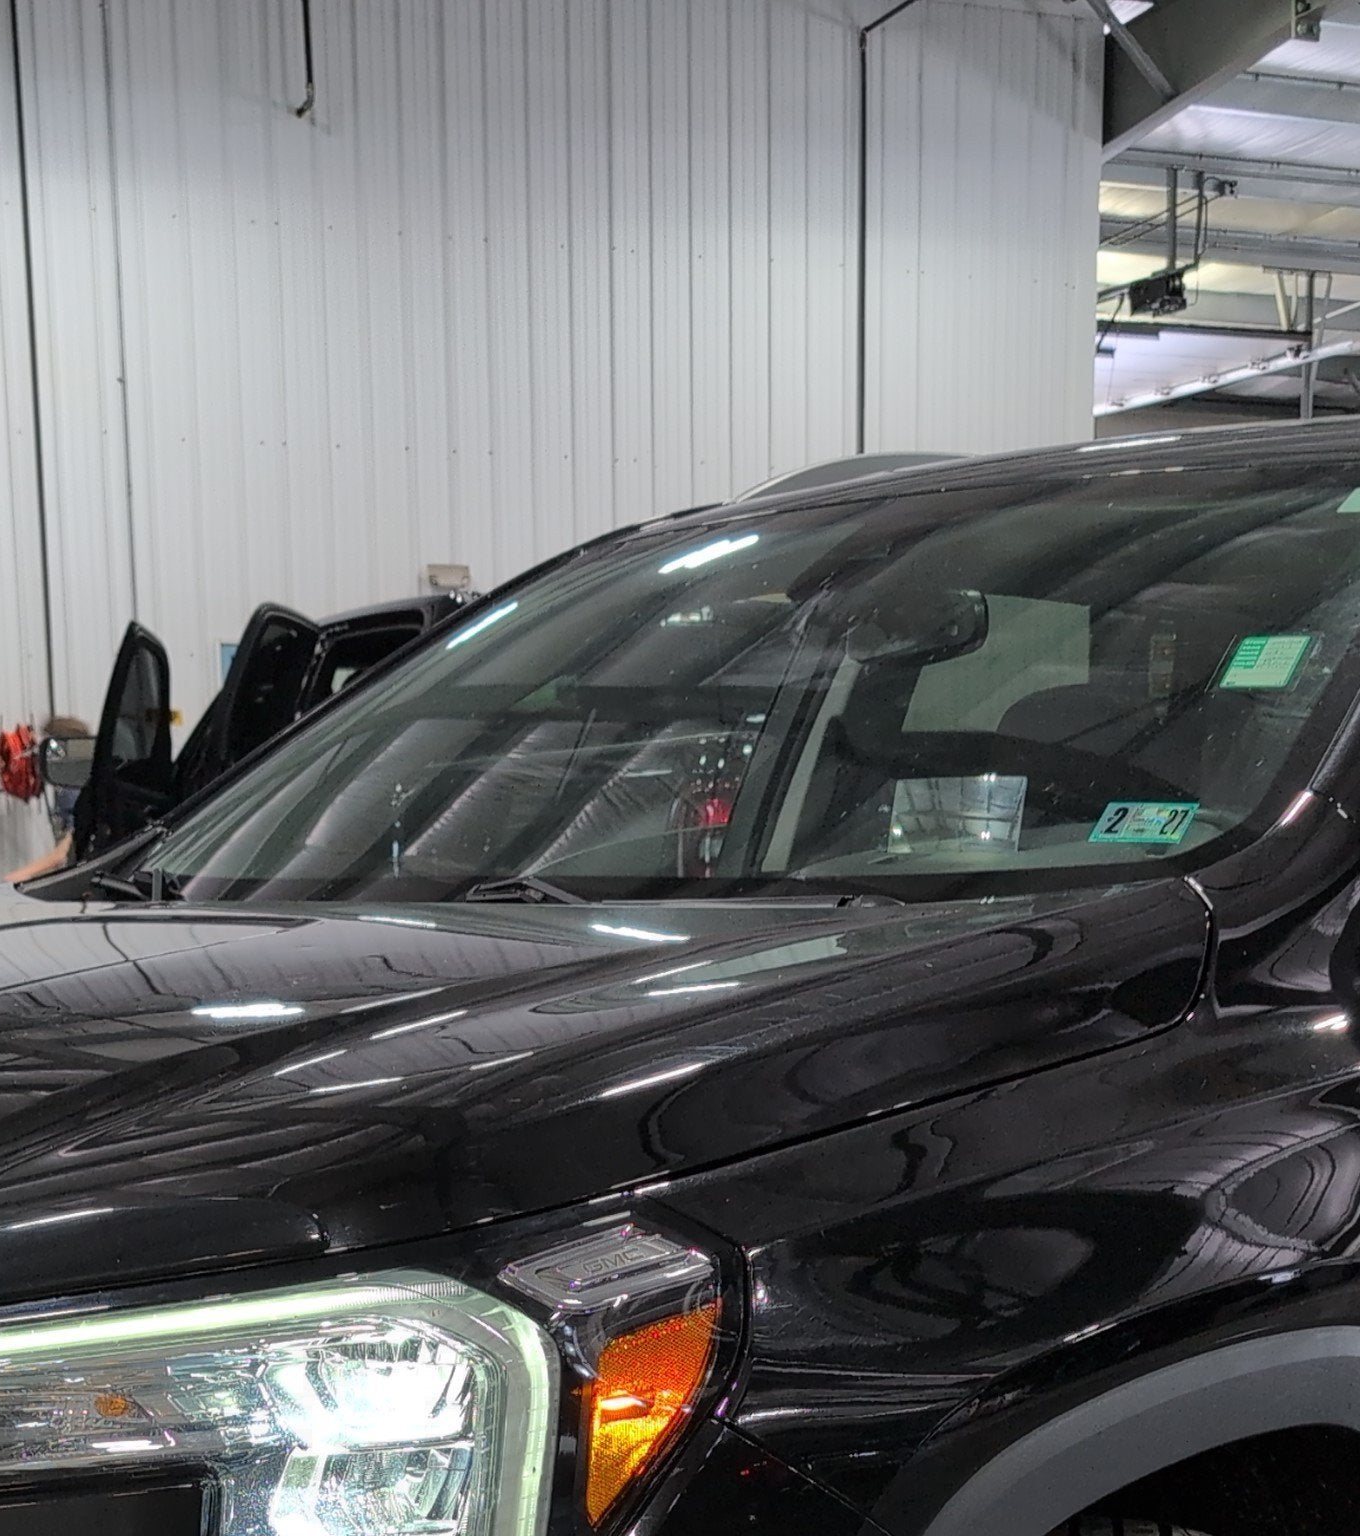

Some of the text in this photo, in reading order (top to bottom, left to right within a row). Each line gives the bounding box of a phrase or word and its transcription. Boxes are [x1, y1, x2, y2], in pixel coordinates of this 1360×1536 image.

[1103, 806, 1130, 834] 2
[1159, 808, 1190, 836] 27
[583, 1247, 644, 1274] GMC
